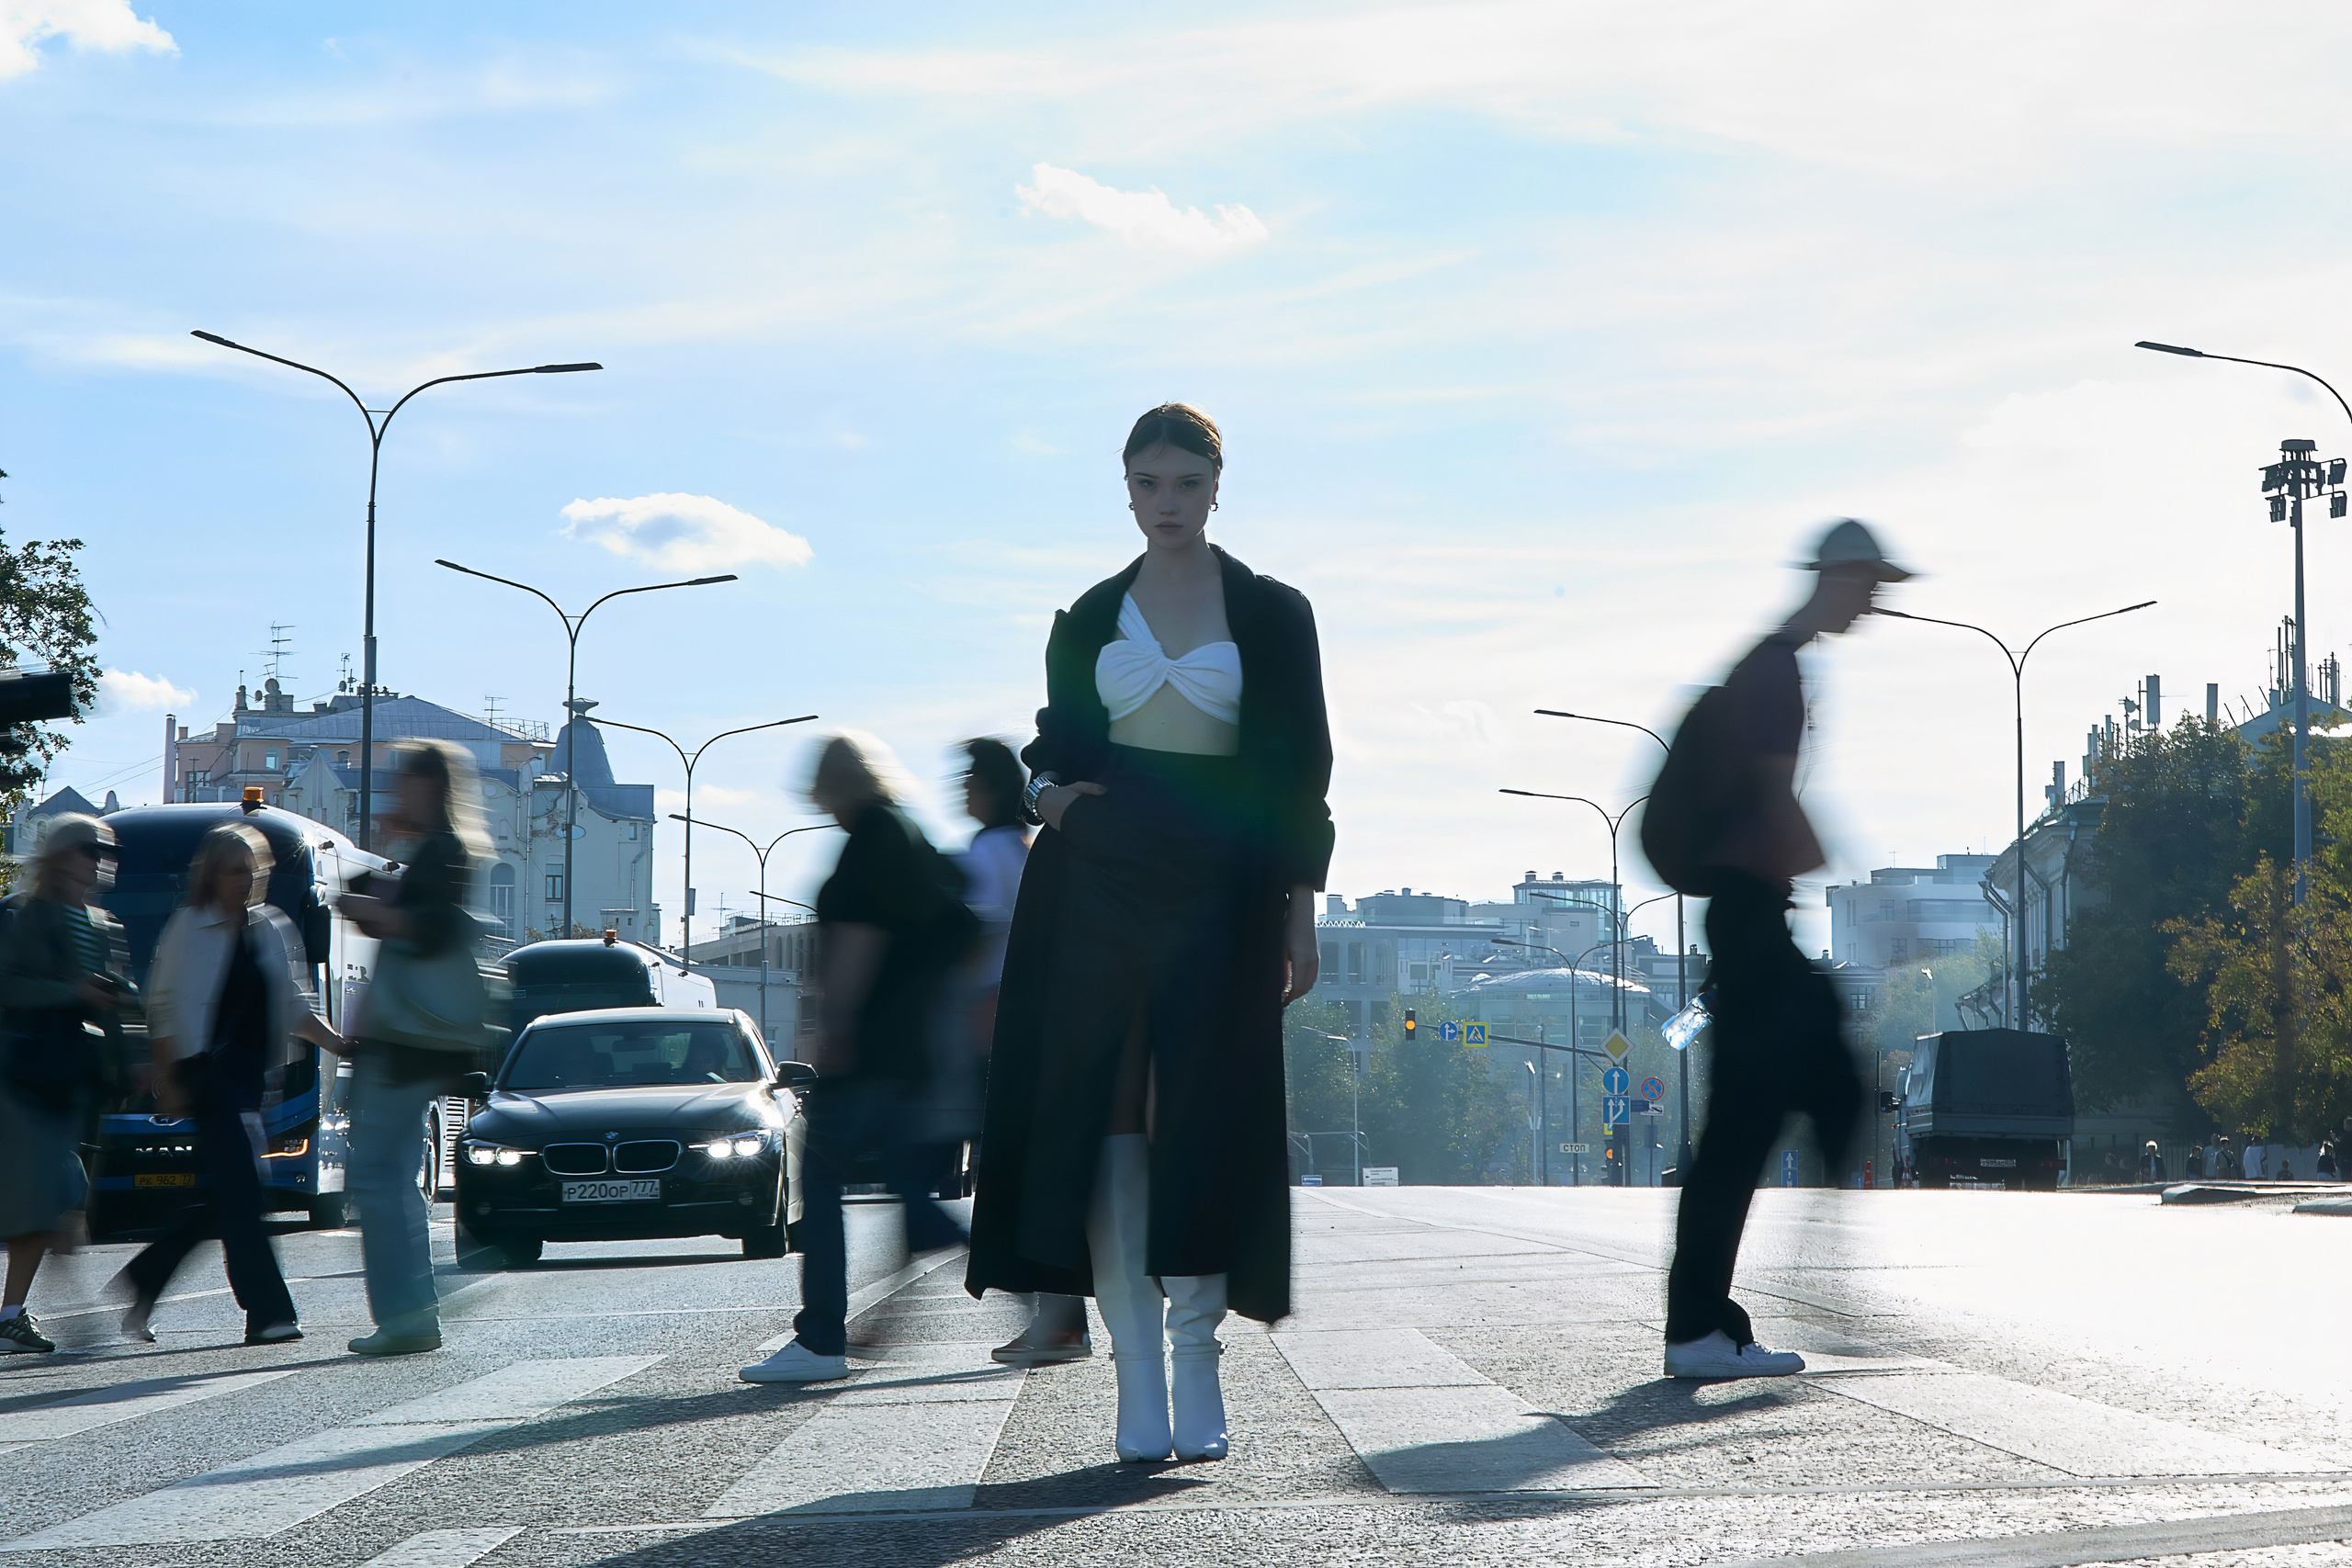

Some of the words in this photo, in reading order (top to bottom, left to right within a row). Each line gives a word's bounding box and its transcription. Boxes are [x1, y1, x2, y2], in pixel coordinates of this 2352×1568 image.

[135, 1145, 193, 1159] MAN
[567, 1183, 628, 1200] Р220ОР
[631, 1180, 655, 1193] 777
